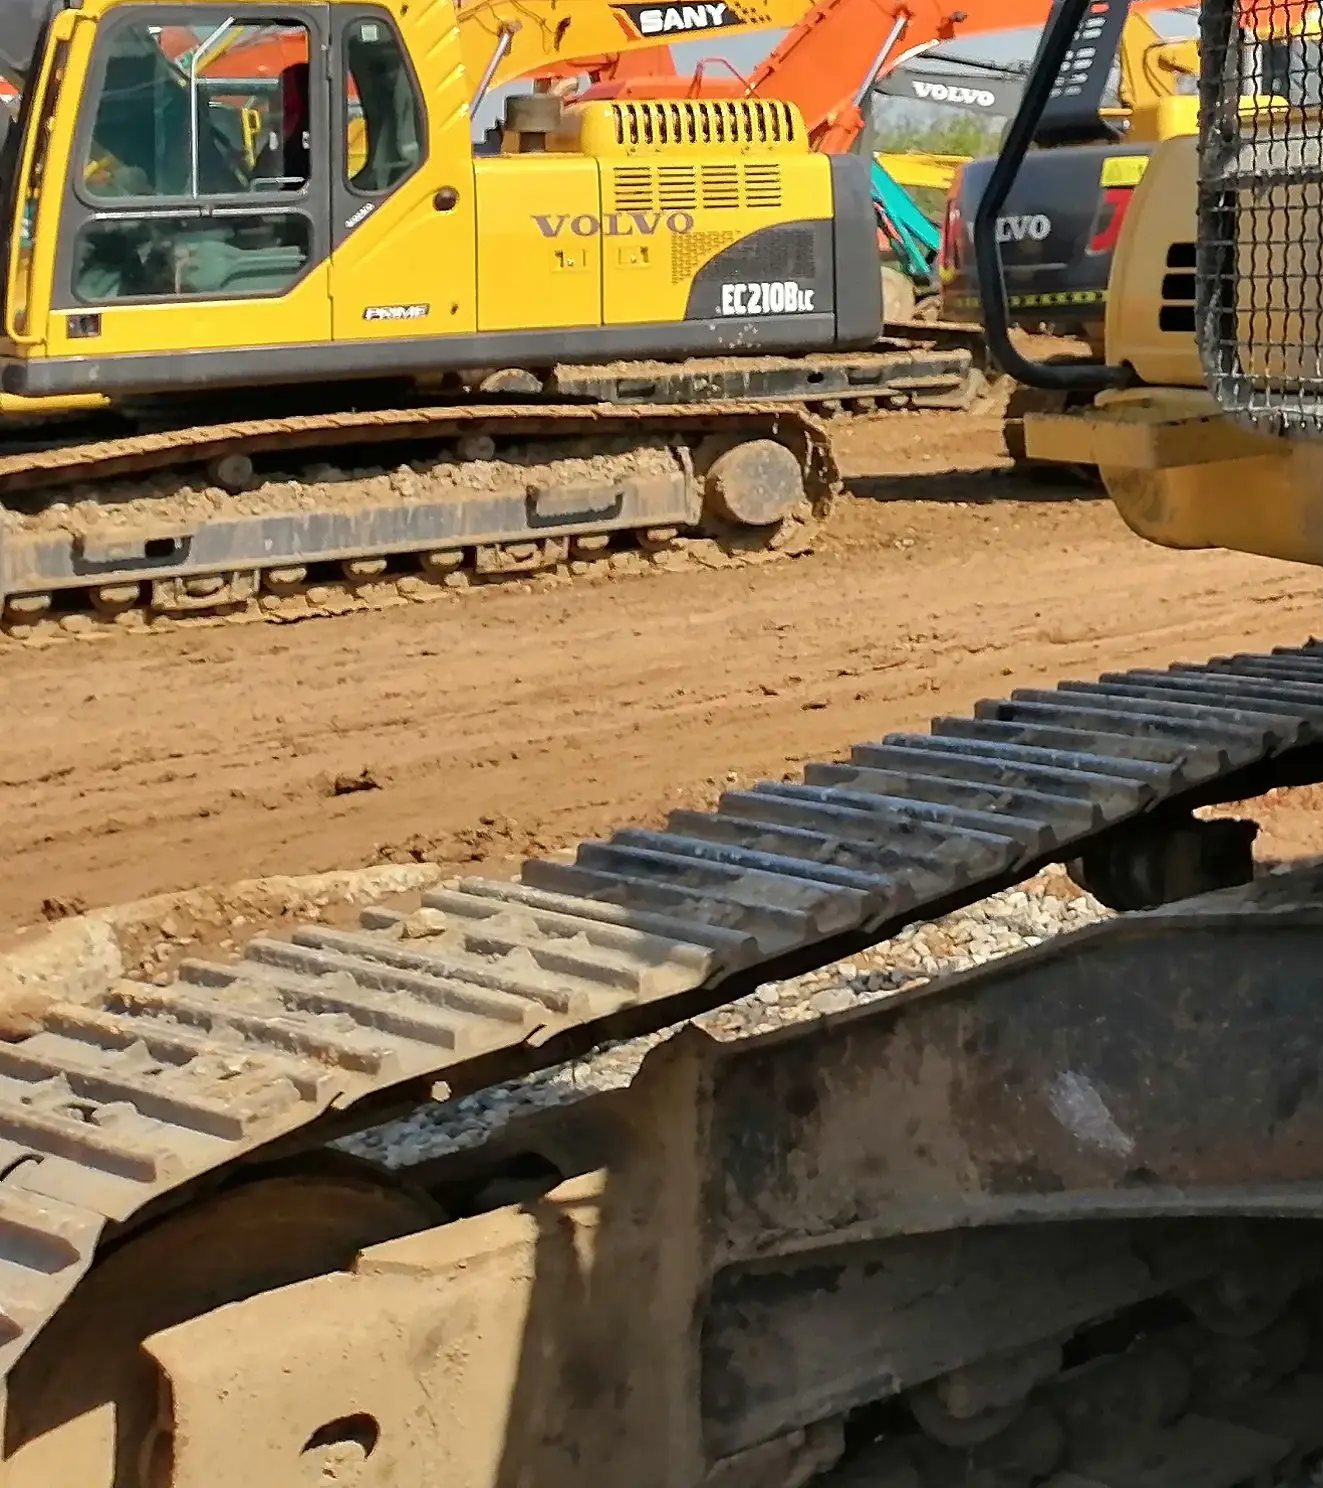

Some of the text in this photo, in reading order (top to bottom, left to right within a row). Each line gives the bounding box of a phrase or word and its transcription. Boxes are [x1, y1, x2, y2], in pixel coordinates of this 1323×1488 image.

[640, 2, 727, 34] SANY
[911, 80, 995, 107] VOLVO
[531, 211, 694, 238] VOLVO
[970, 214, 1051, 242] LVO
